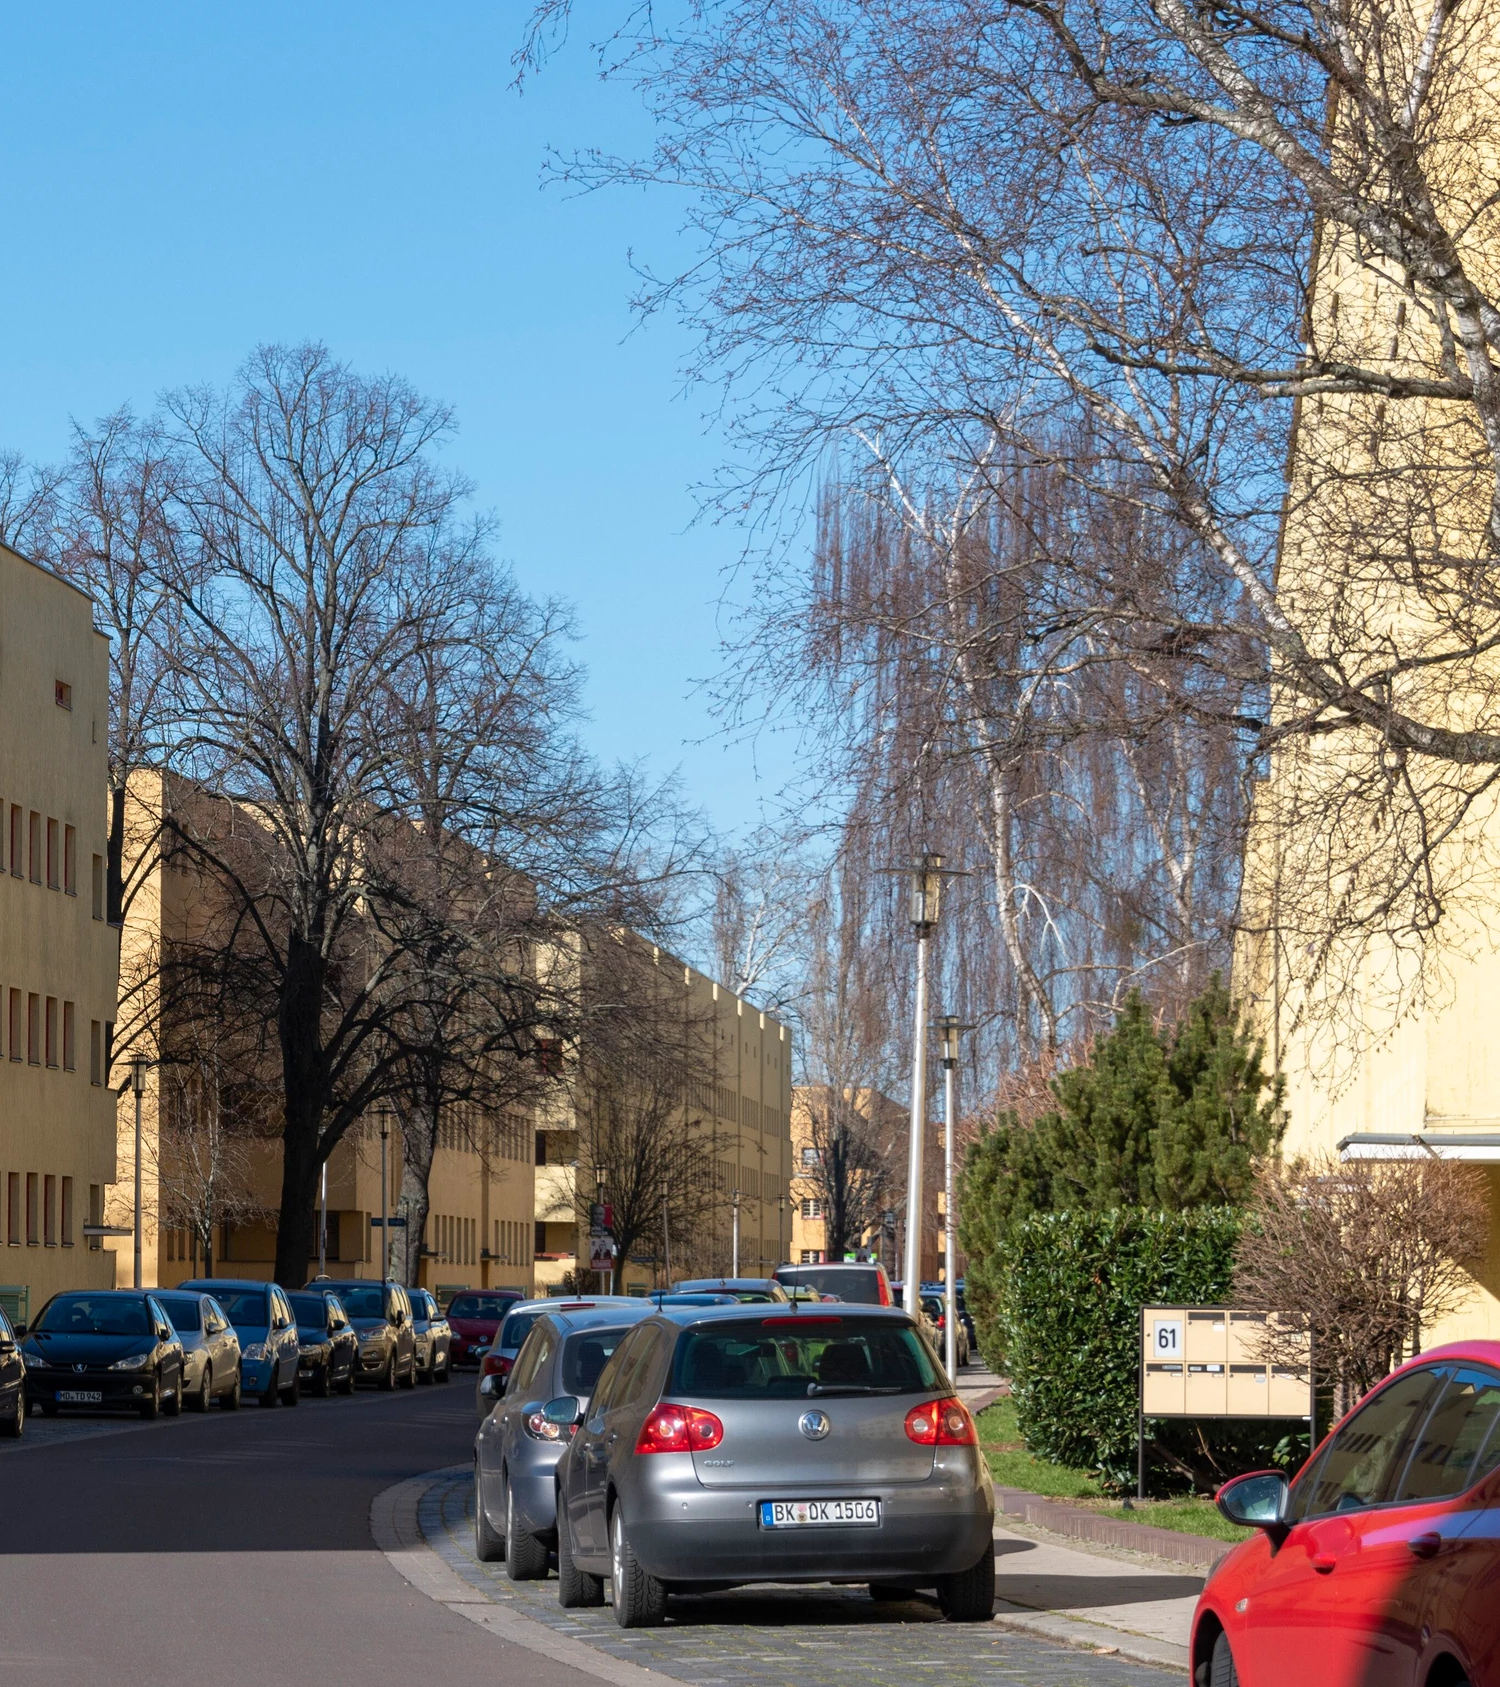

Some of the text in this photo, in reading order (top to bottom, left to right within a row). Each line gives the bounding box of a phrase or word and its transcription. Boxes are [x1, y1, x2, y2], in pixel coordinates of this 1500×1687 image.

[1158, 1328, 1176, 1348] 61
[703, 1460, 734, 1468] GOLF
[774, 1504, 795, 1521] BK
[834, 1502, 875, 1520] 1506
